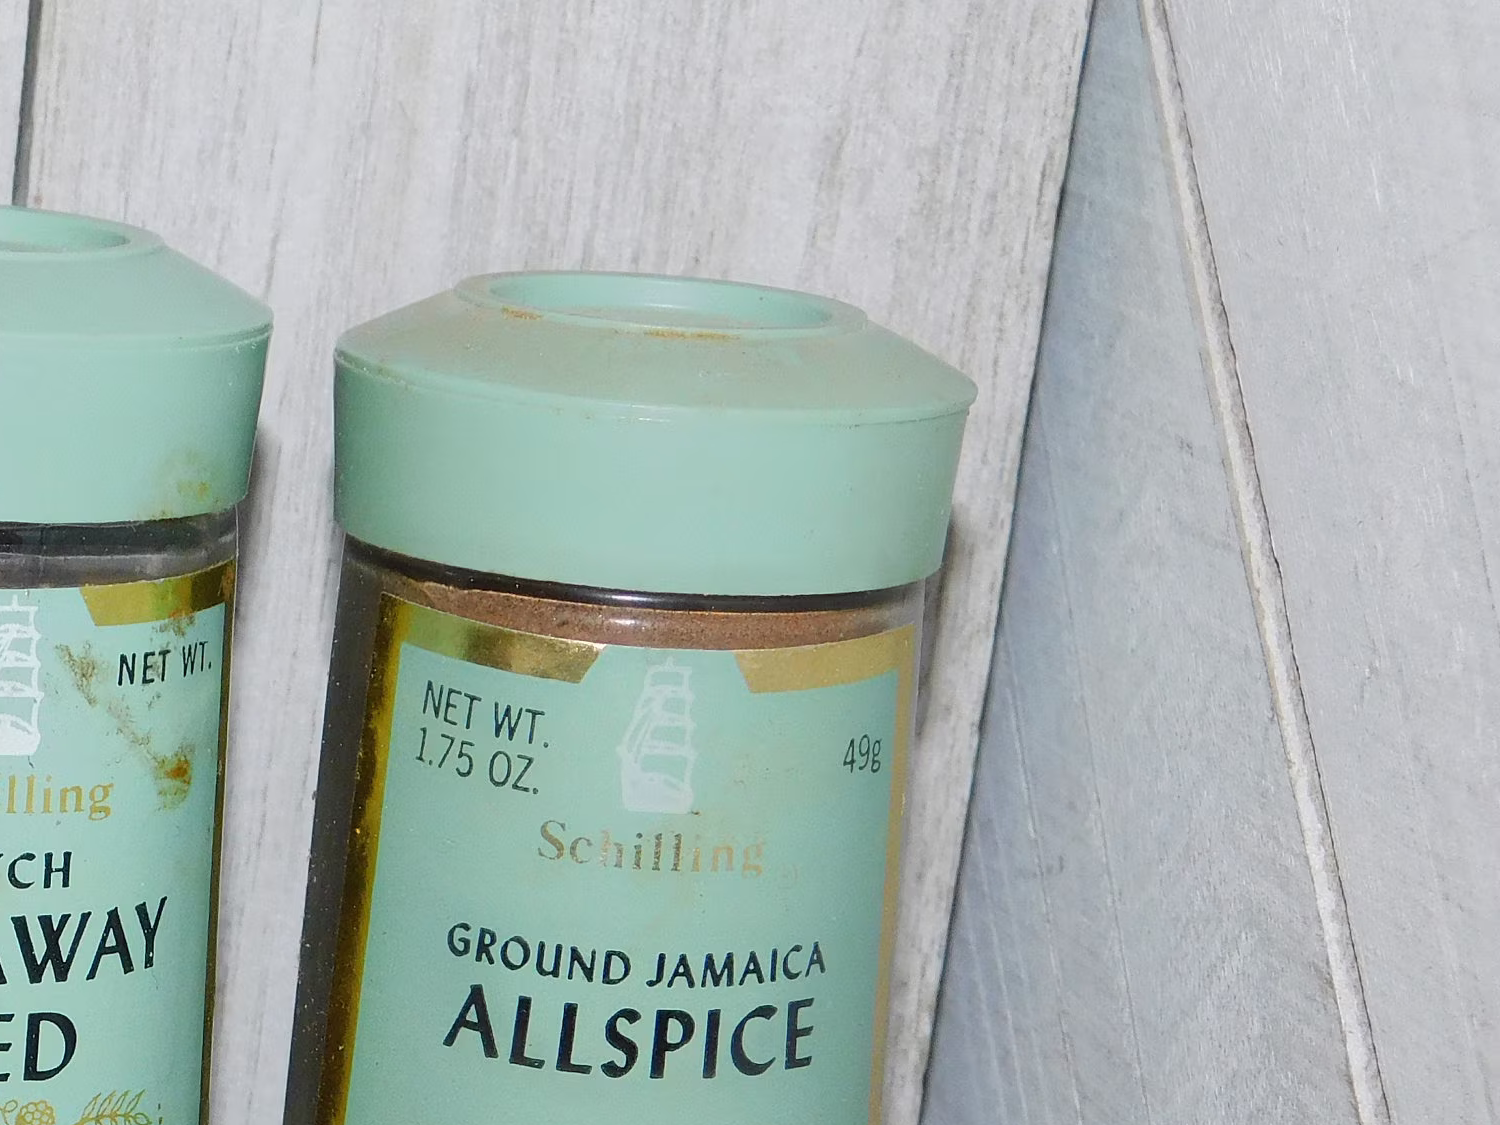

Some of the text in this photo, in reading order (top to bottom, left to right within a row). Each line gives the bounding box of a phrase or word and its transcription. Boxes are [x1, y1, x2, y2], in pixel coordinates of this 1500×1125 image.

[117, 640, 212, 687] NET WT.
[422, 679, 549, 749] NET WT.
[415, 727, 539, 795] 1.75 OZ.
[842, 733, 883, 774] 49g
[537, 819, 767, 879] Schilling
[447, 922, 827, 989] GROUND JAMAICA
[442, 984, 815, 1079] ALLSPICE
